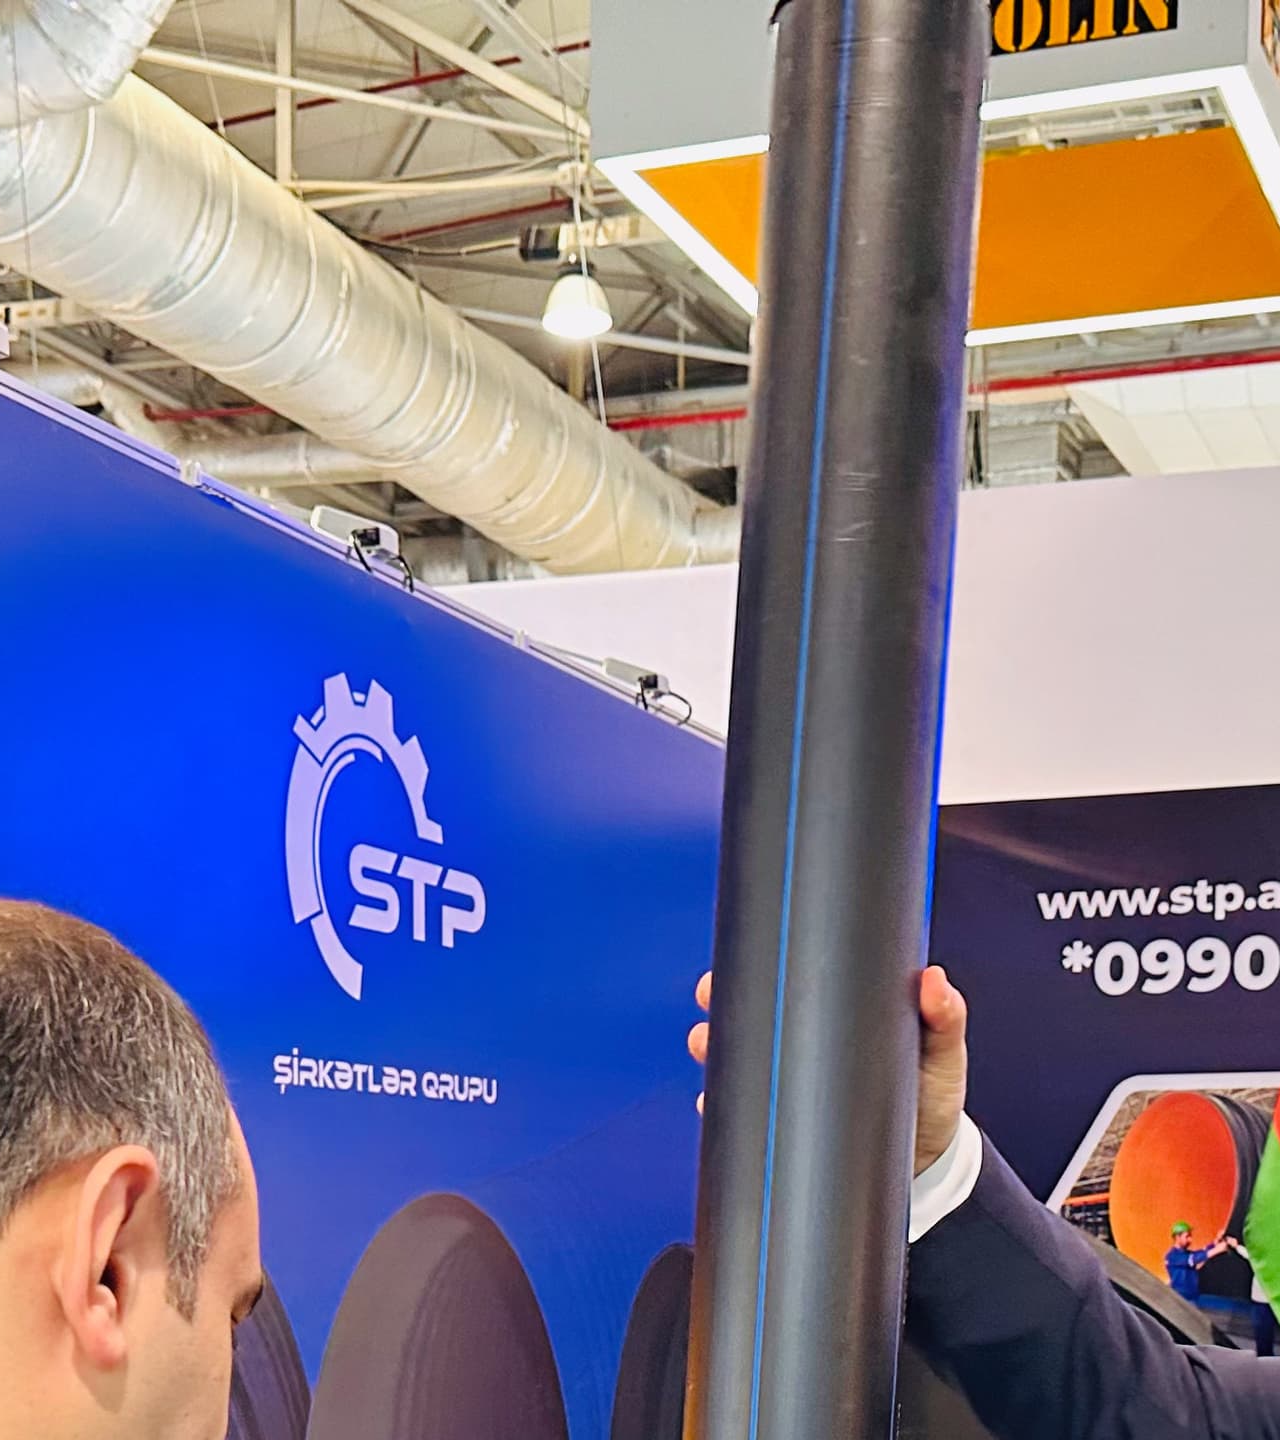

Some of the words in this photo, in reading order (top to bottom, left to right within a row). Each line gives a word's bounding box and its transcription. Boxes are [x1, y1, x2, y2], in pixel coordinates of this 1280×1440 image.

[994, 0, 1169, 52] OLIN
[348, 843, 486, 948] STP
[421, 1071, 499, 1105] QRUPU
